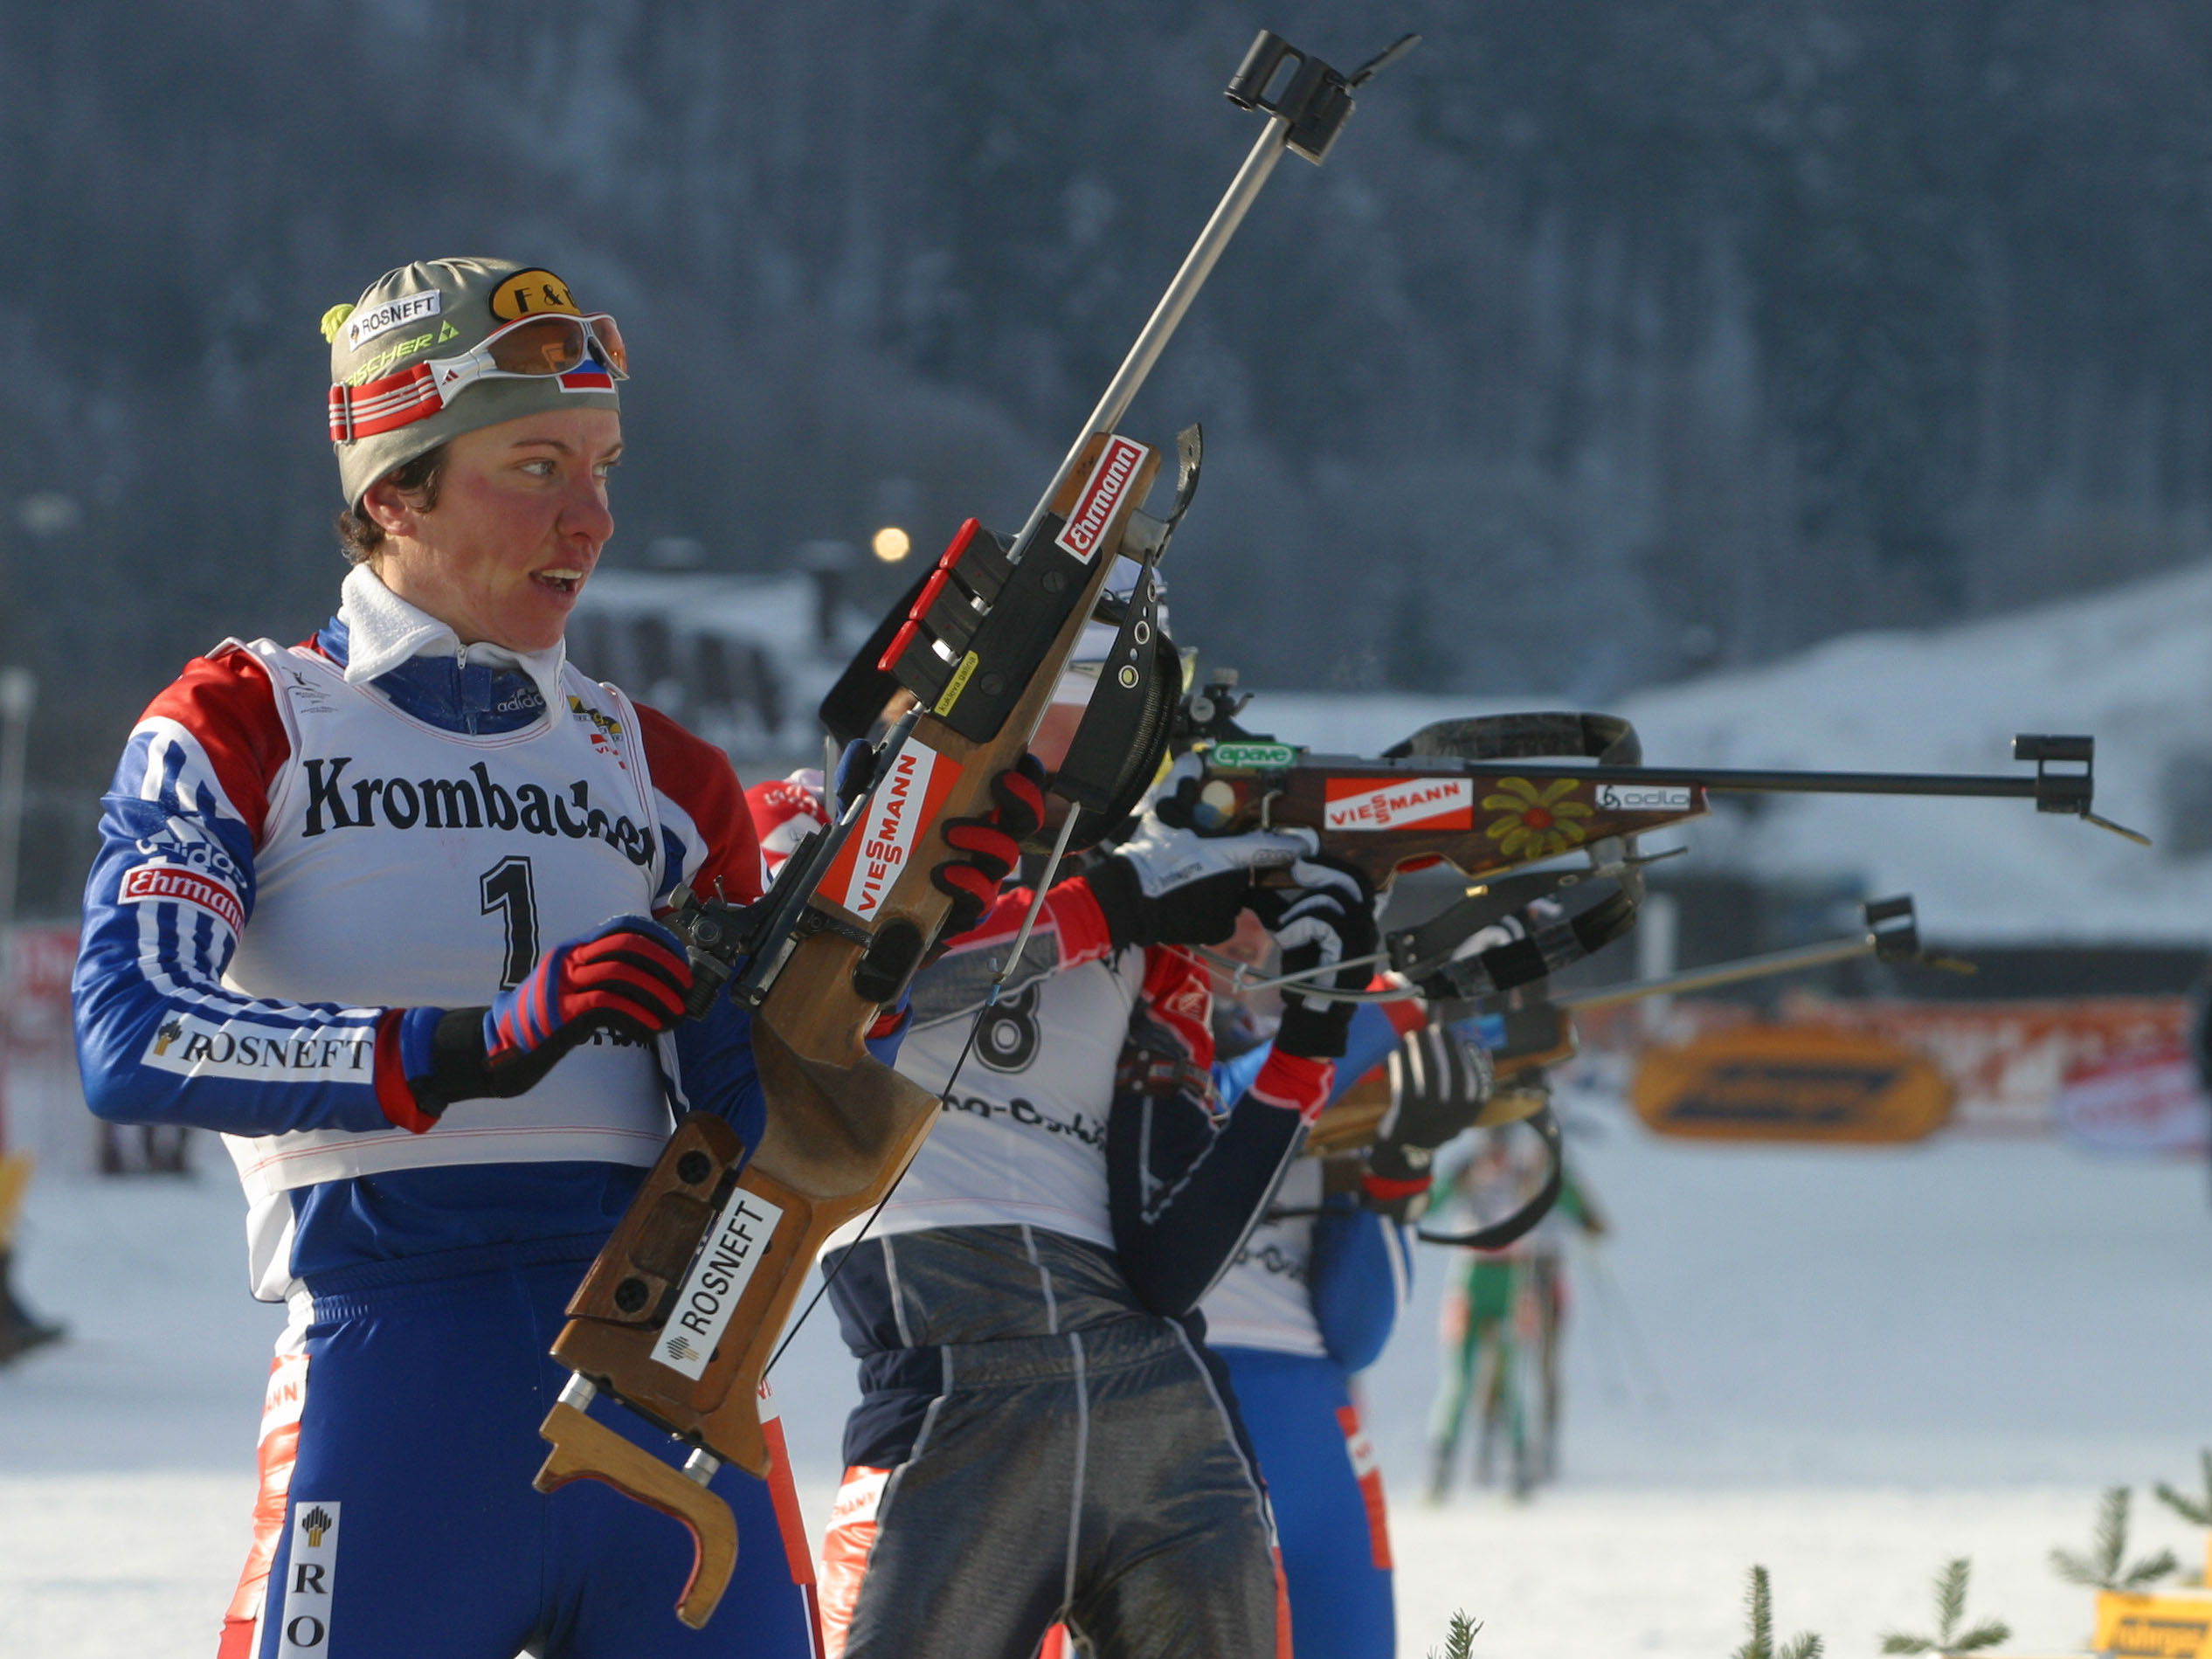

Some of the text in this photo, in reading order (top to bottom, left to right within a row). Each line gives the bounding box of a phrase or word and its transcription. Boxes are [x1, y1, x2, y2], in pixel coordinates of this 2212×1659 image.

[362, 295, 435, 335] ROSNEFT
[1070, 446, 1136, 550] Ehrmann
[857, 754, 917, 911] VIESSMANN
[1330, 782, 1461, 825] VIESSMANN
[480, 854, 540, 991] 1
[182, 1031, 374, 1070] ROSNEFT
[971, 980, 1041, 1075] 8
[680, 1199, 764, 1336] ROSNEFT
